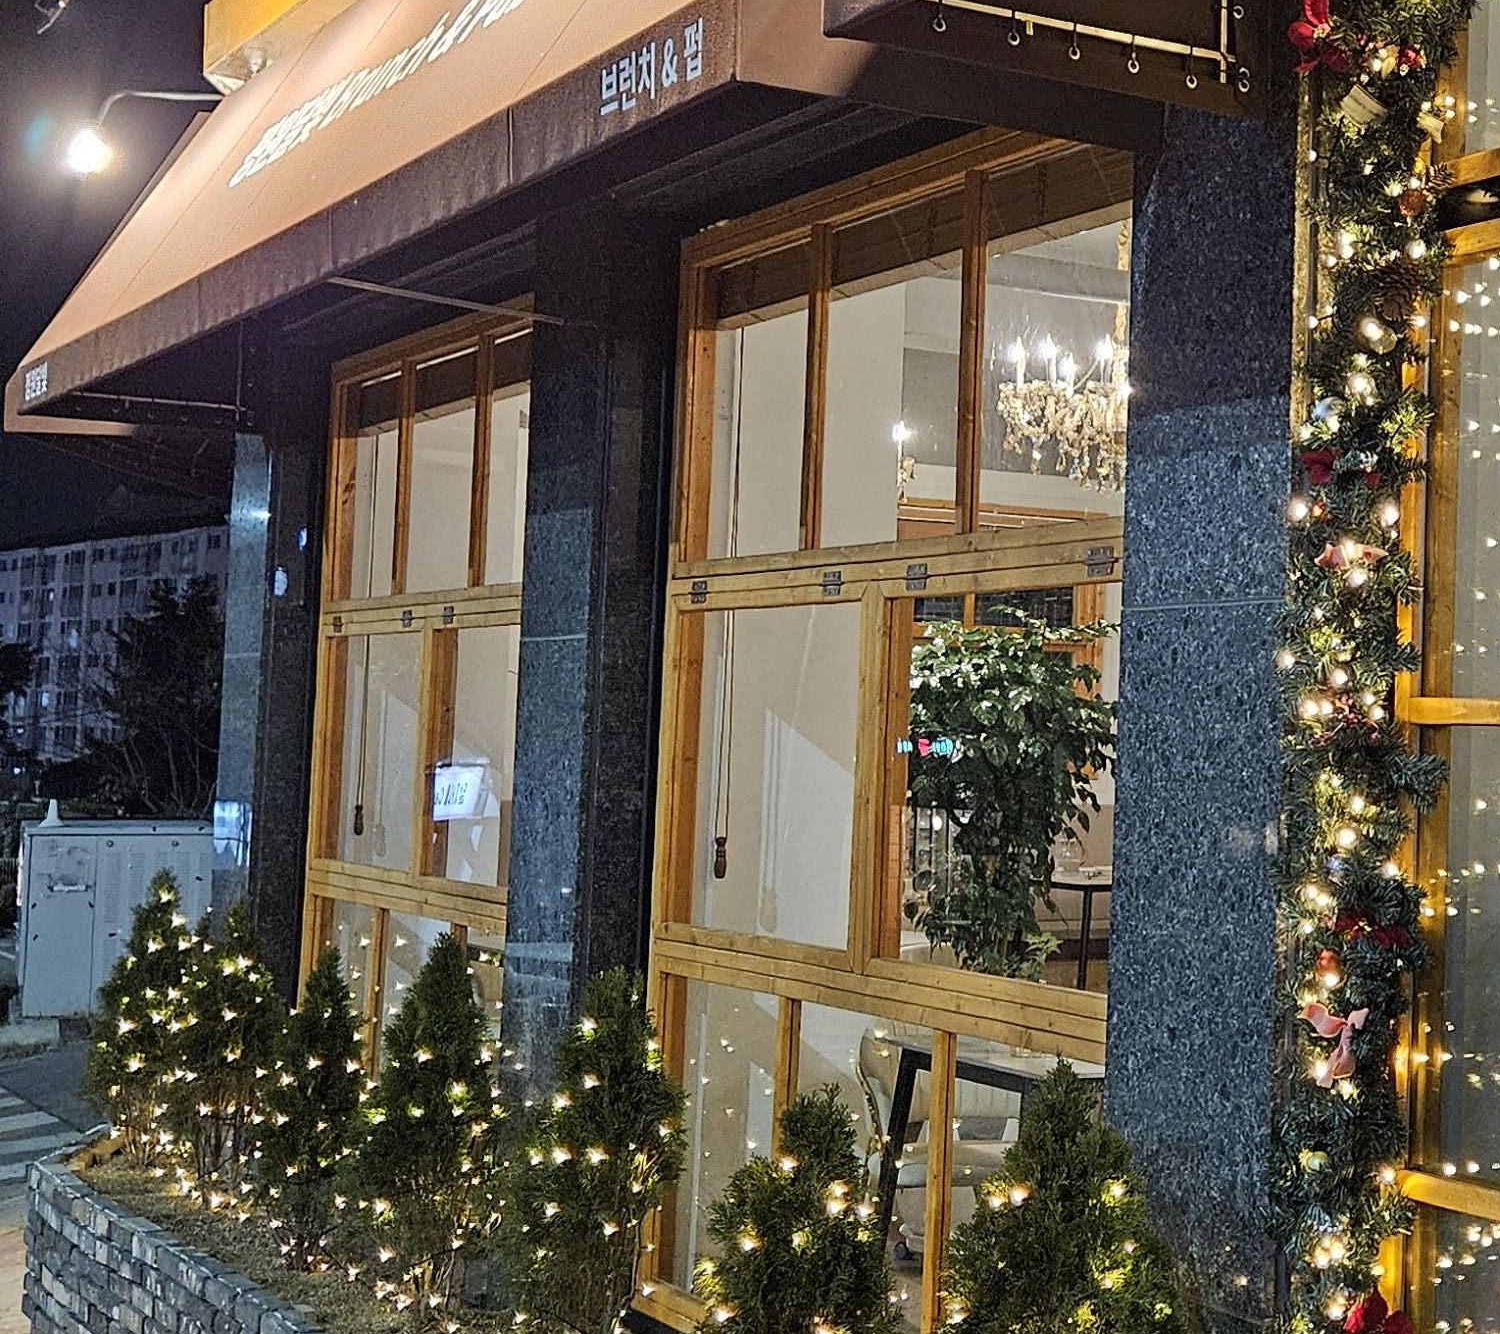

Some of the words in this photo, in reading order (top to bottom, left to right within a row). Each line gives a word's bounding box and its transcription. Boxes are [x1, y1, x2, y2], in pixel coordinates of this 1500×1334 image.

[318, 11, 451, 130] Brunch
[600, 42, 655, 115] 브런치
[662, 38, 678, 87] &
[684, 17, 703, 81] 펍
